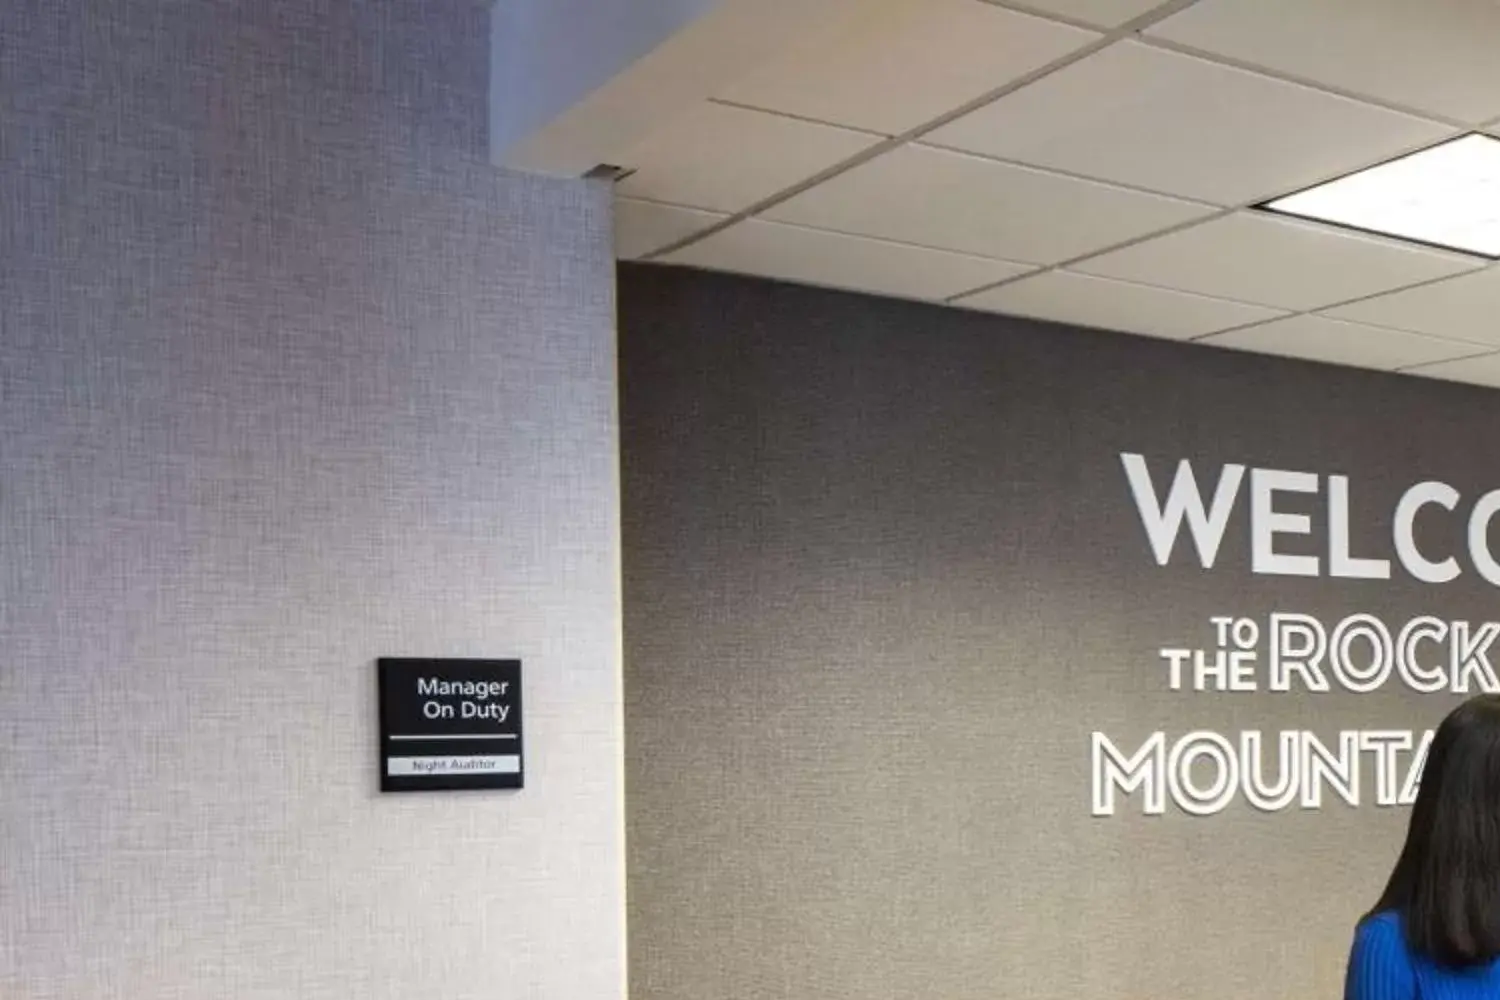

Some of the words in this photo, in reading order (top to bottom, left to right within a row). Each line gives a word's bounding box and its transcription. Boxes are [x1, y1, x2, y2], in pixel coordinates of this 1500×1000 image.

[1210, 616, 1259, 650] TO
[1160, 648, 1258, 691] THE
[417, 677, 509, 699] Manager
[423, 701, 455, 719] On
[461, 701, 510, 723] Duty
